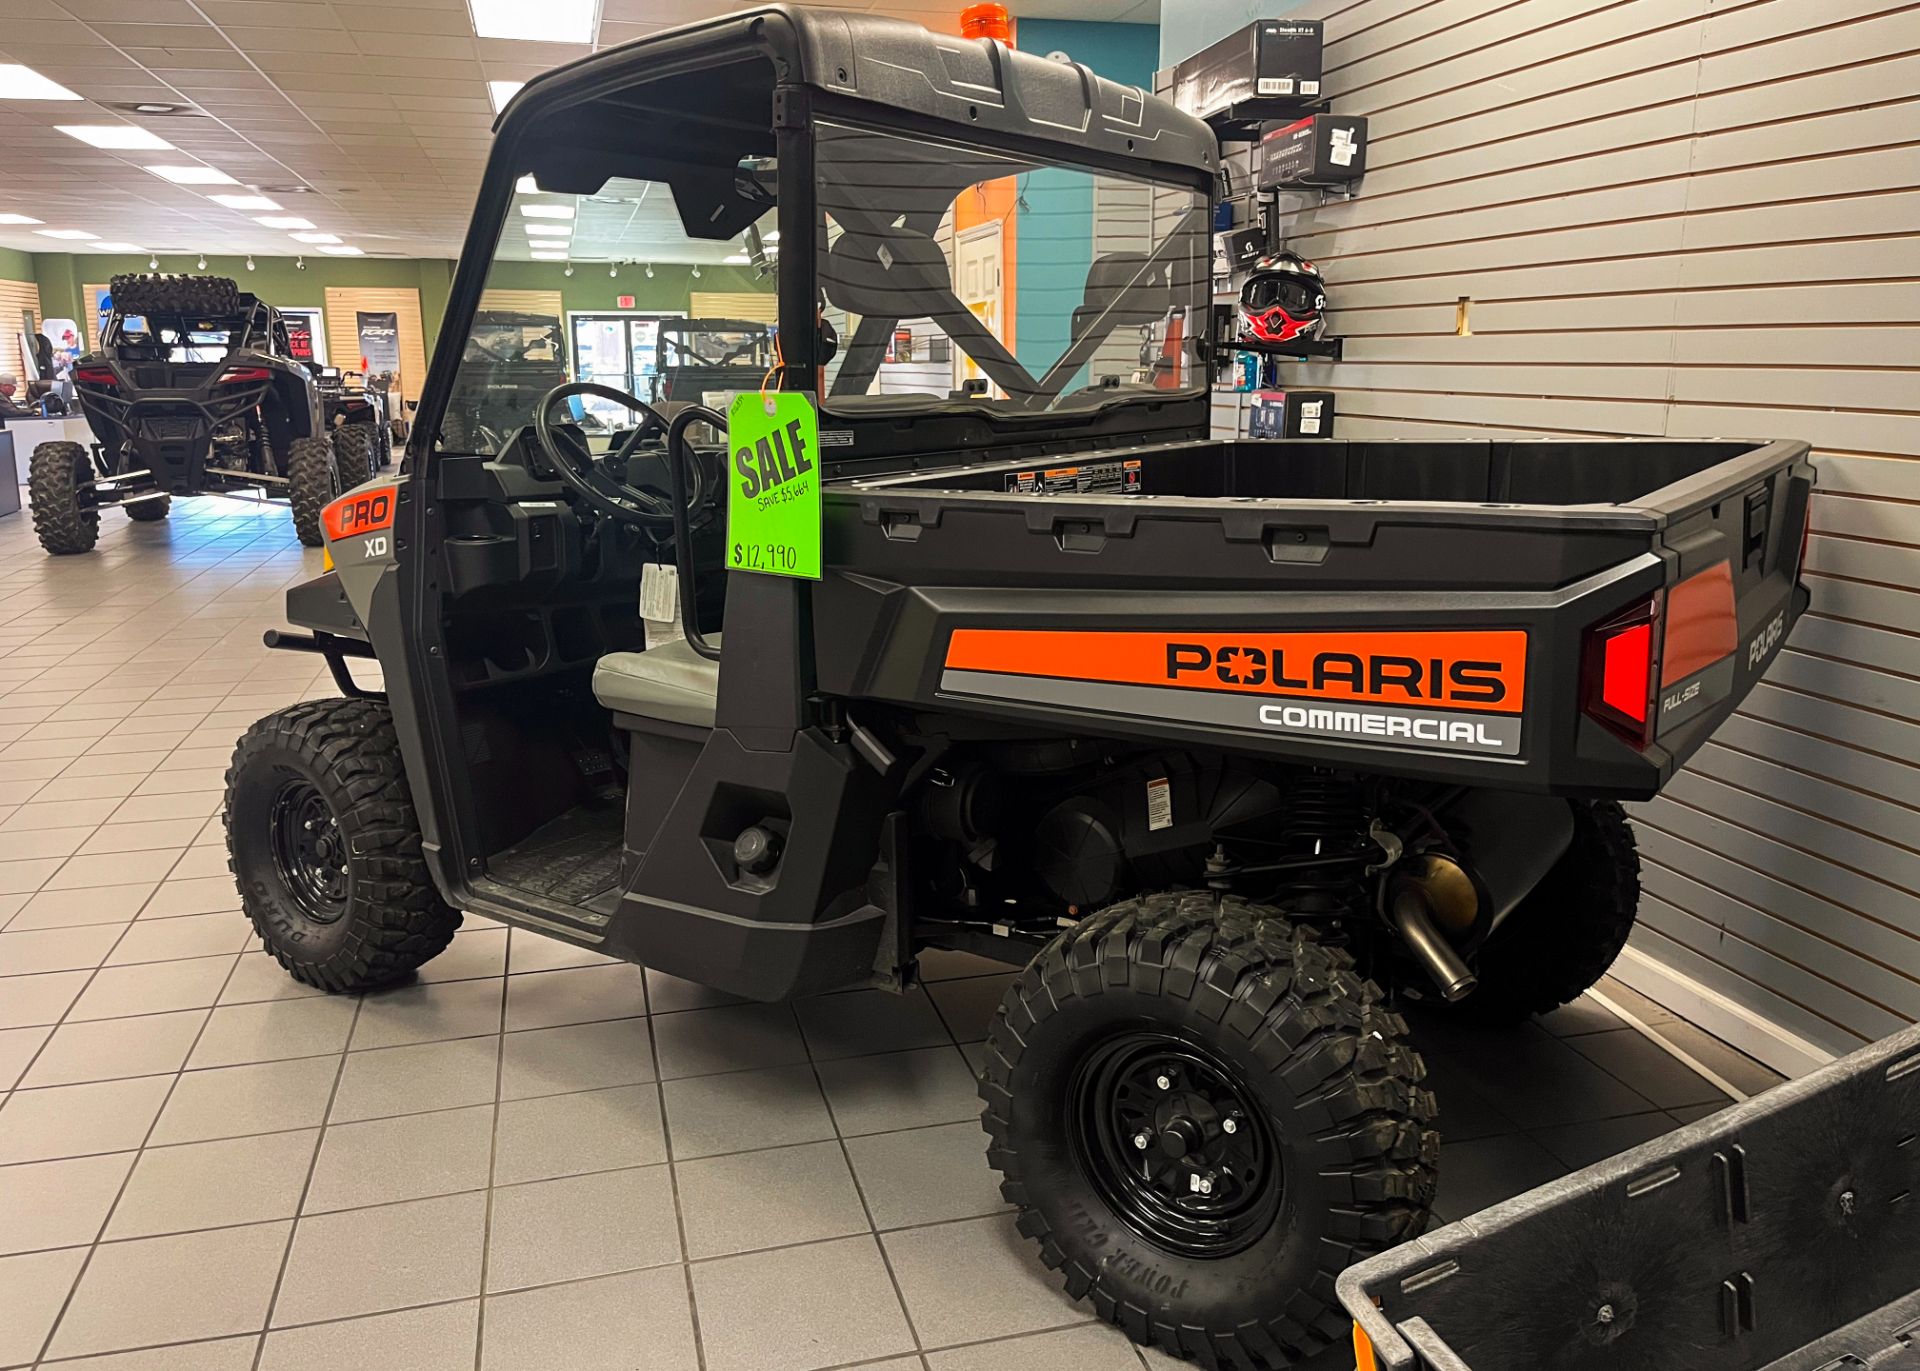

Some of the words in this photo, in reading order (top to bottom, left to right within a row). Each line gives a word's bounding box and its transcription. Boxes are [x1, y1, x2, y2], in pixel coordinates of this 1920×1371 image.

[735, 418, 813, 499] SALE
[342, 496, 388, 532] PRO
[758, 491, 781, 512] SAVE
[781, 480, 810, 503] $5,664
[364, 536, 387, 558] XD
[1747, 610, 1784, 671] POLARIS
[1167, 643, 1506, 703] POLARIS
[1663, 681, 1700, 713] FULL-SIZE
[1259, 704, 1503, 746] COMMERCIAL
[253, 880, 307, 942] DURO
[1102, 1248, 1189, 1298] POWER
